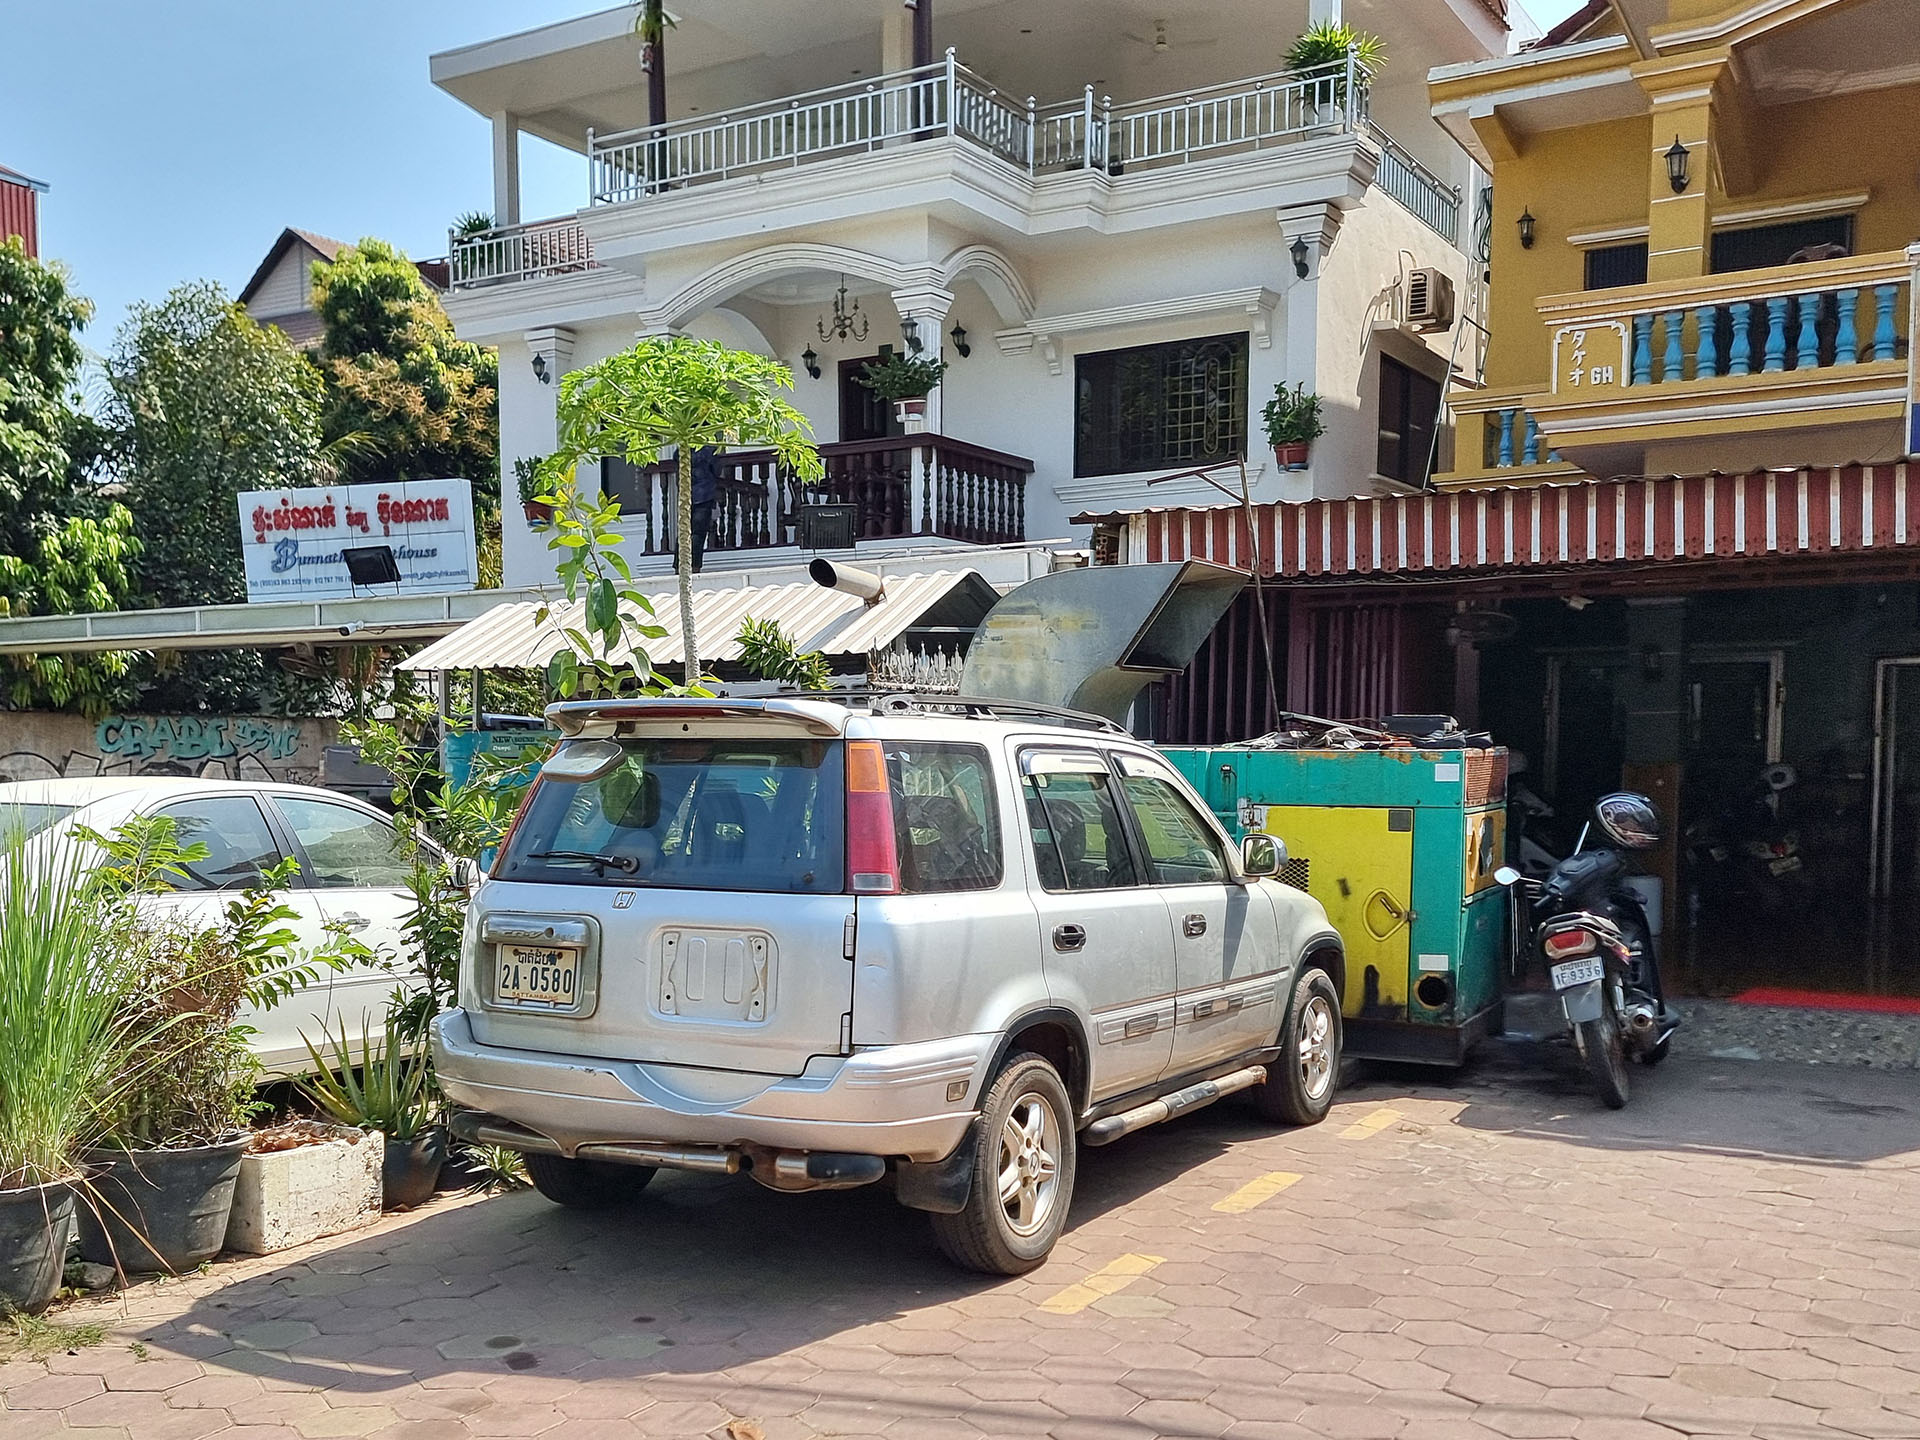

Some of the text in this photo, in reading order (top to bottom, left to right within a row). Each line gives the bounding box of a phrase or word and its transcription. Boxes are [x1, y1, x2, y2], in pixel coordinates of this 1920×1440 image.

[1568, 330, 1586, 387] タケオ
[1590, 366, 1614, 385] GH
[501, 964, 573, 994] 2A-0580
